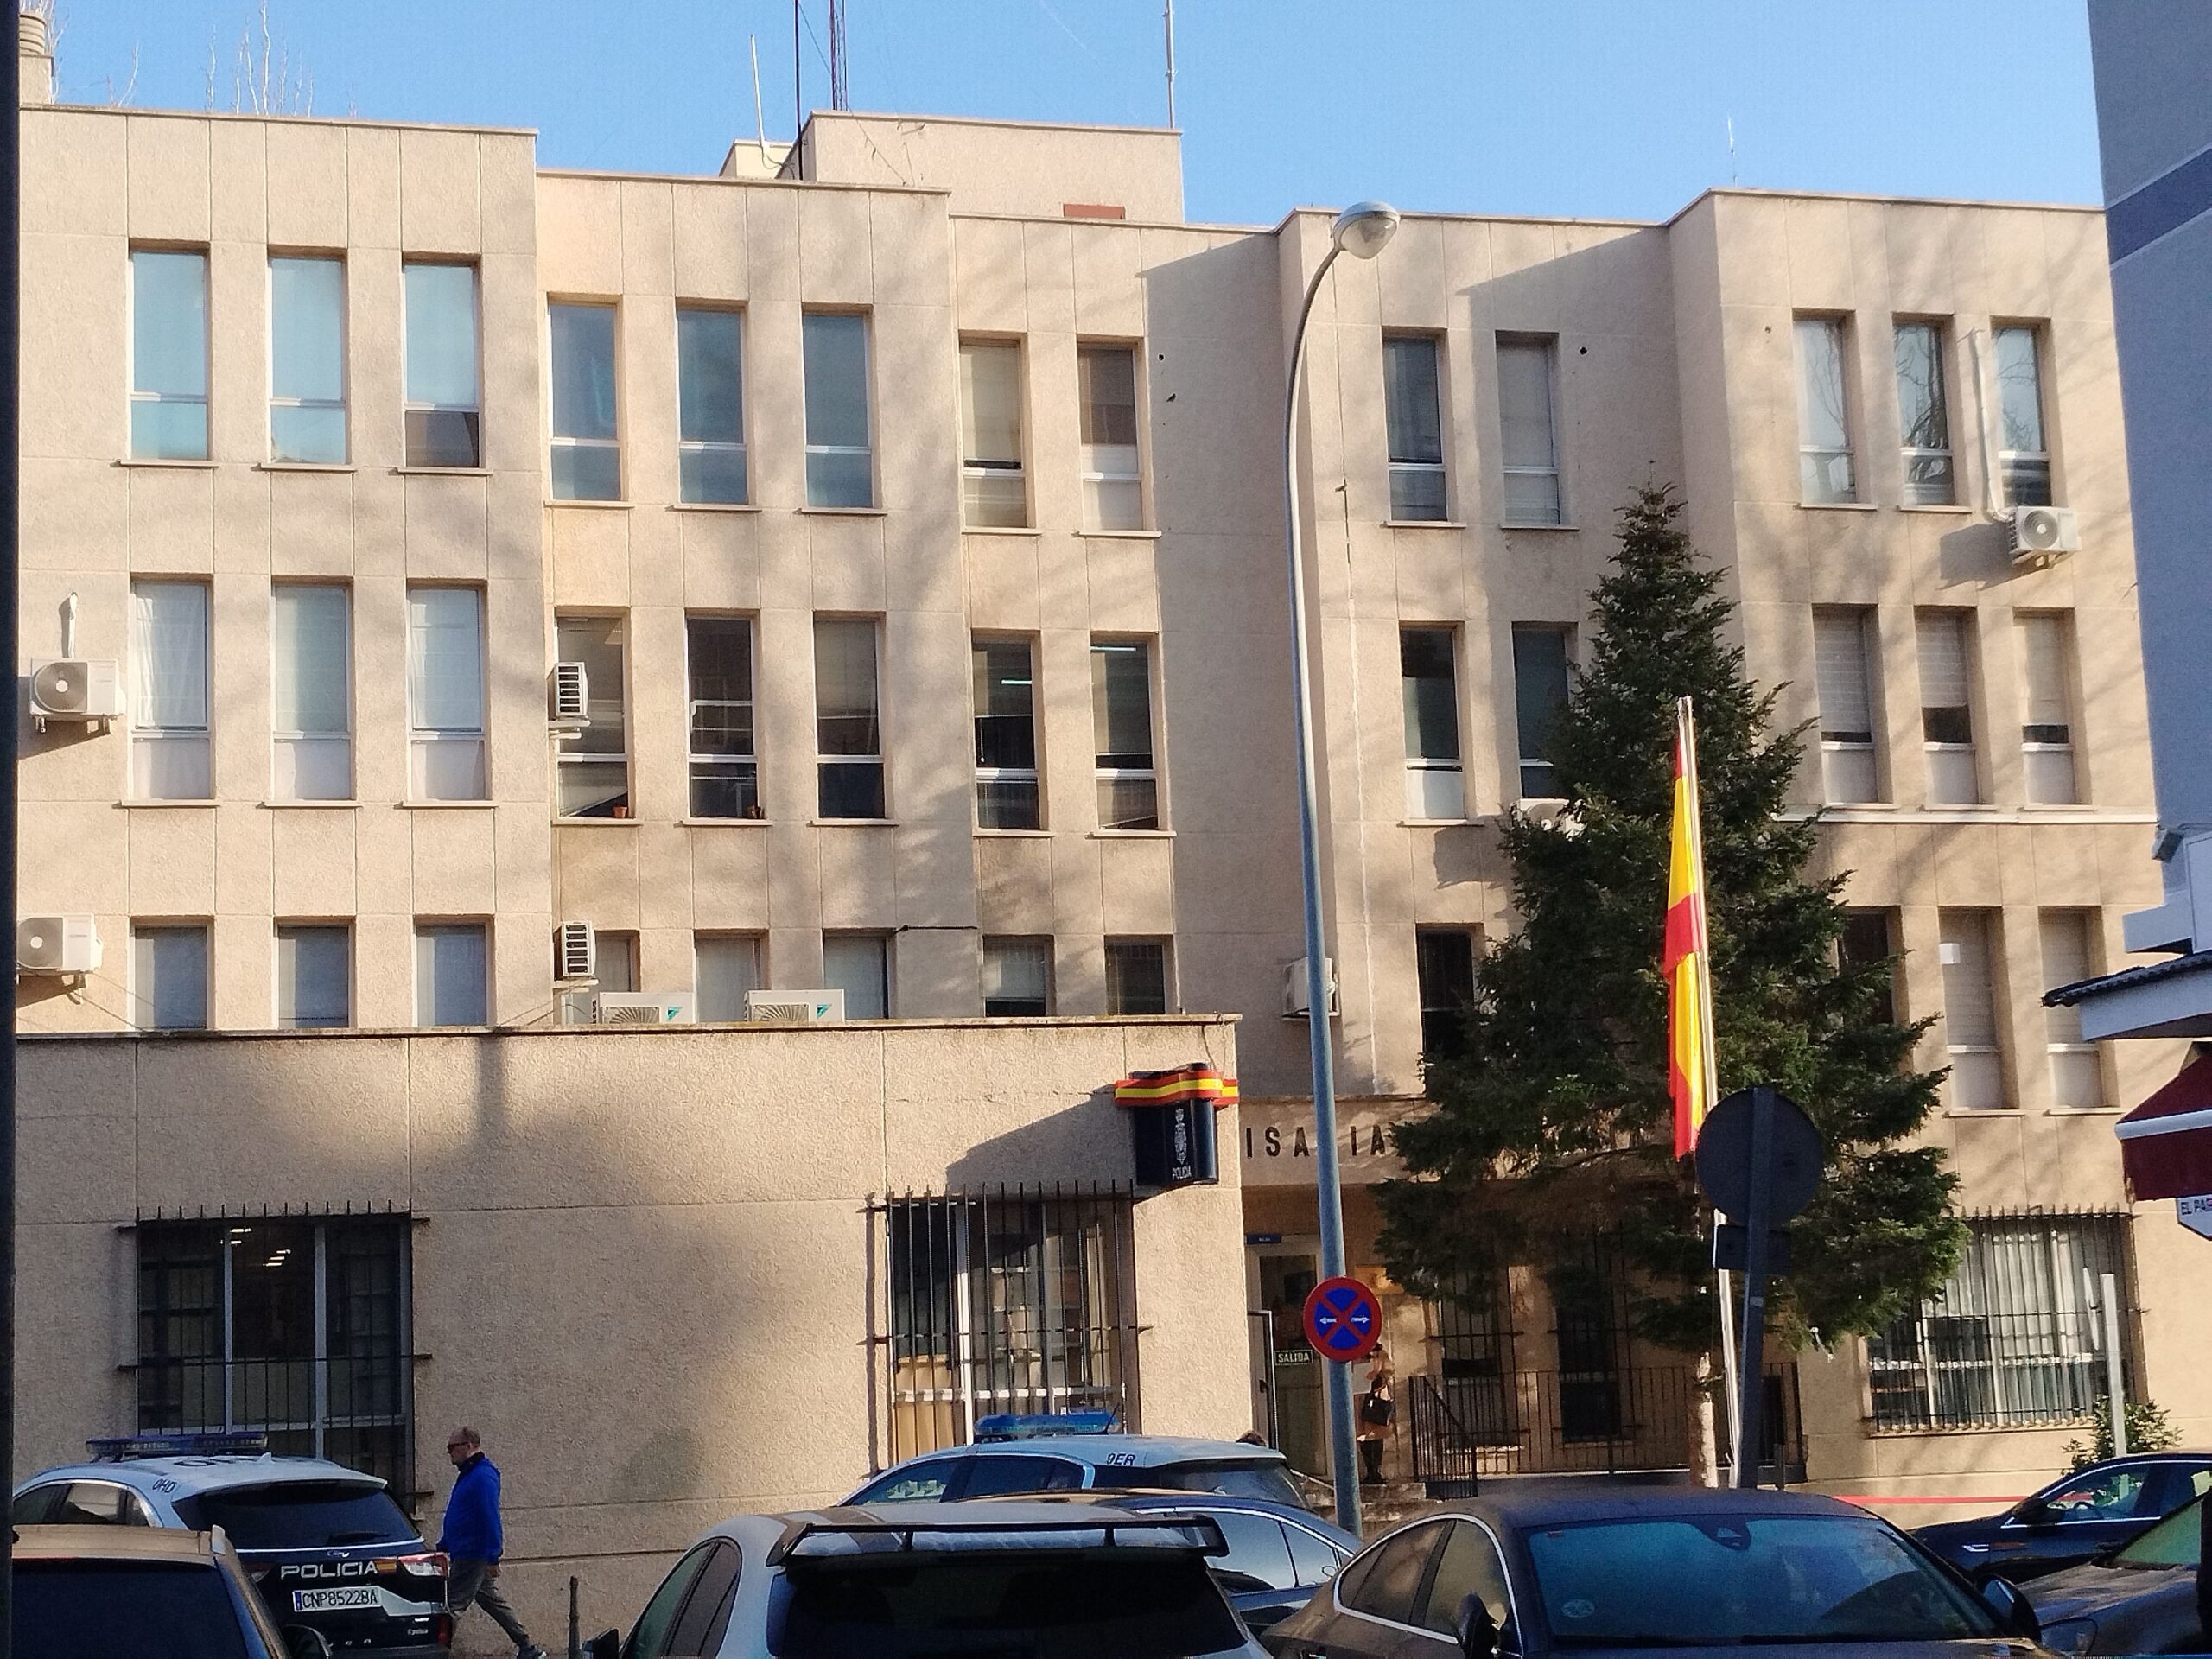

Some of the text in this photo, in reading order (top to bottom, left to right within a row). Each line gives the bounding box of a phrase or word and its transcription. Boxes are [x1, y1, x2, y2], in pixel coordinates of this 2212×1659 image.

[1244, 1126, 1387, 1159] ISAIA
[1278, 1352, 1310, 1363] SALIDA
[280, 1560, 378, 1580] POLICIA
[302, 1589, 378, 1609] CNP8522BA
